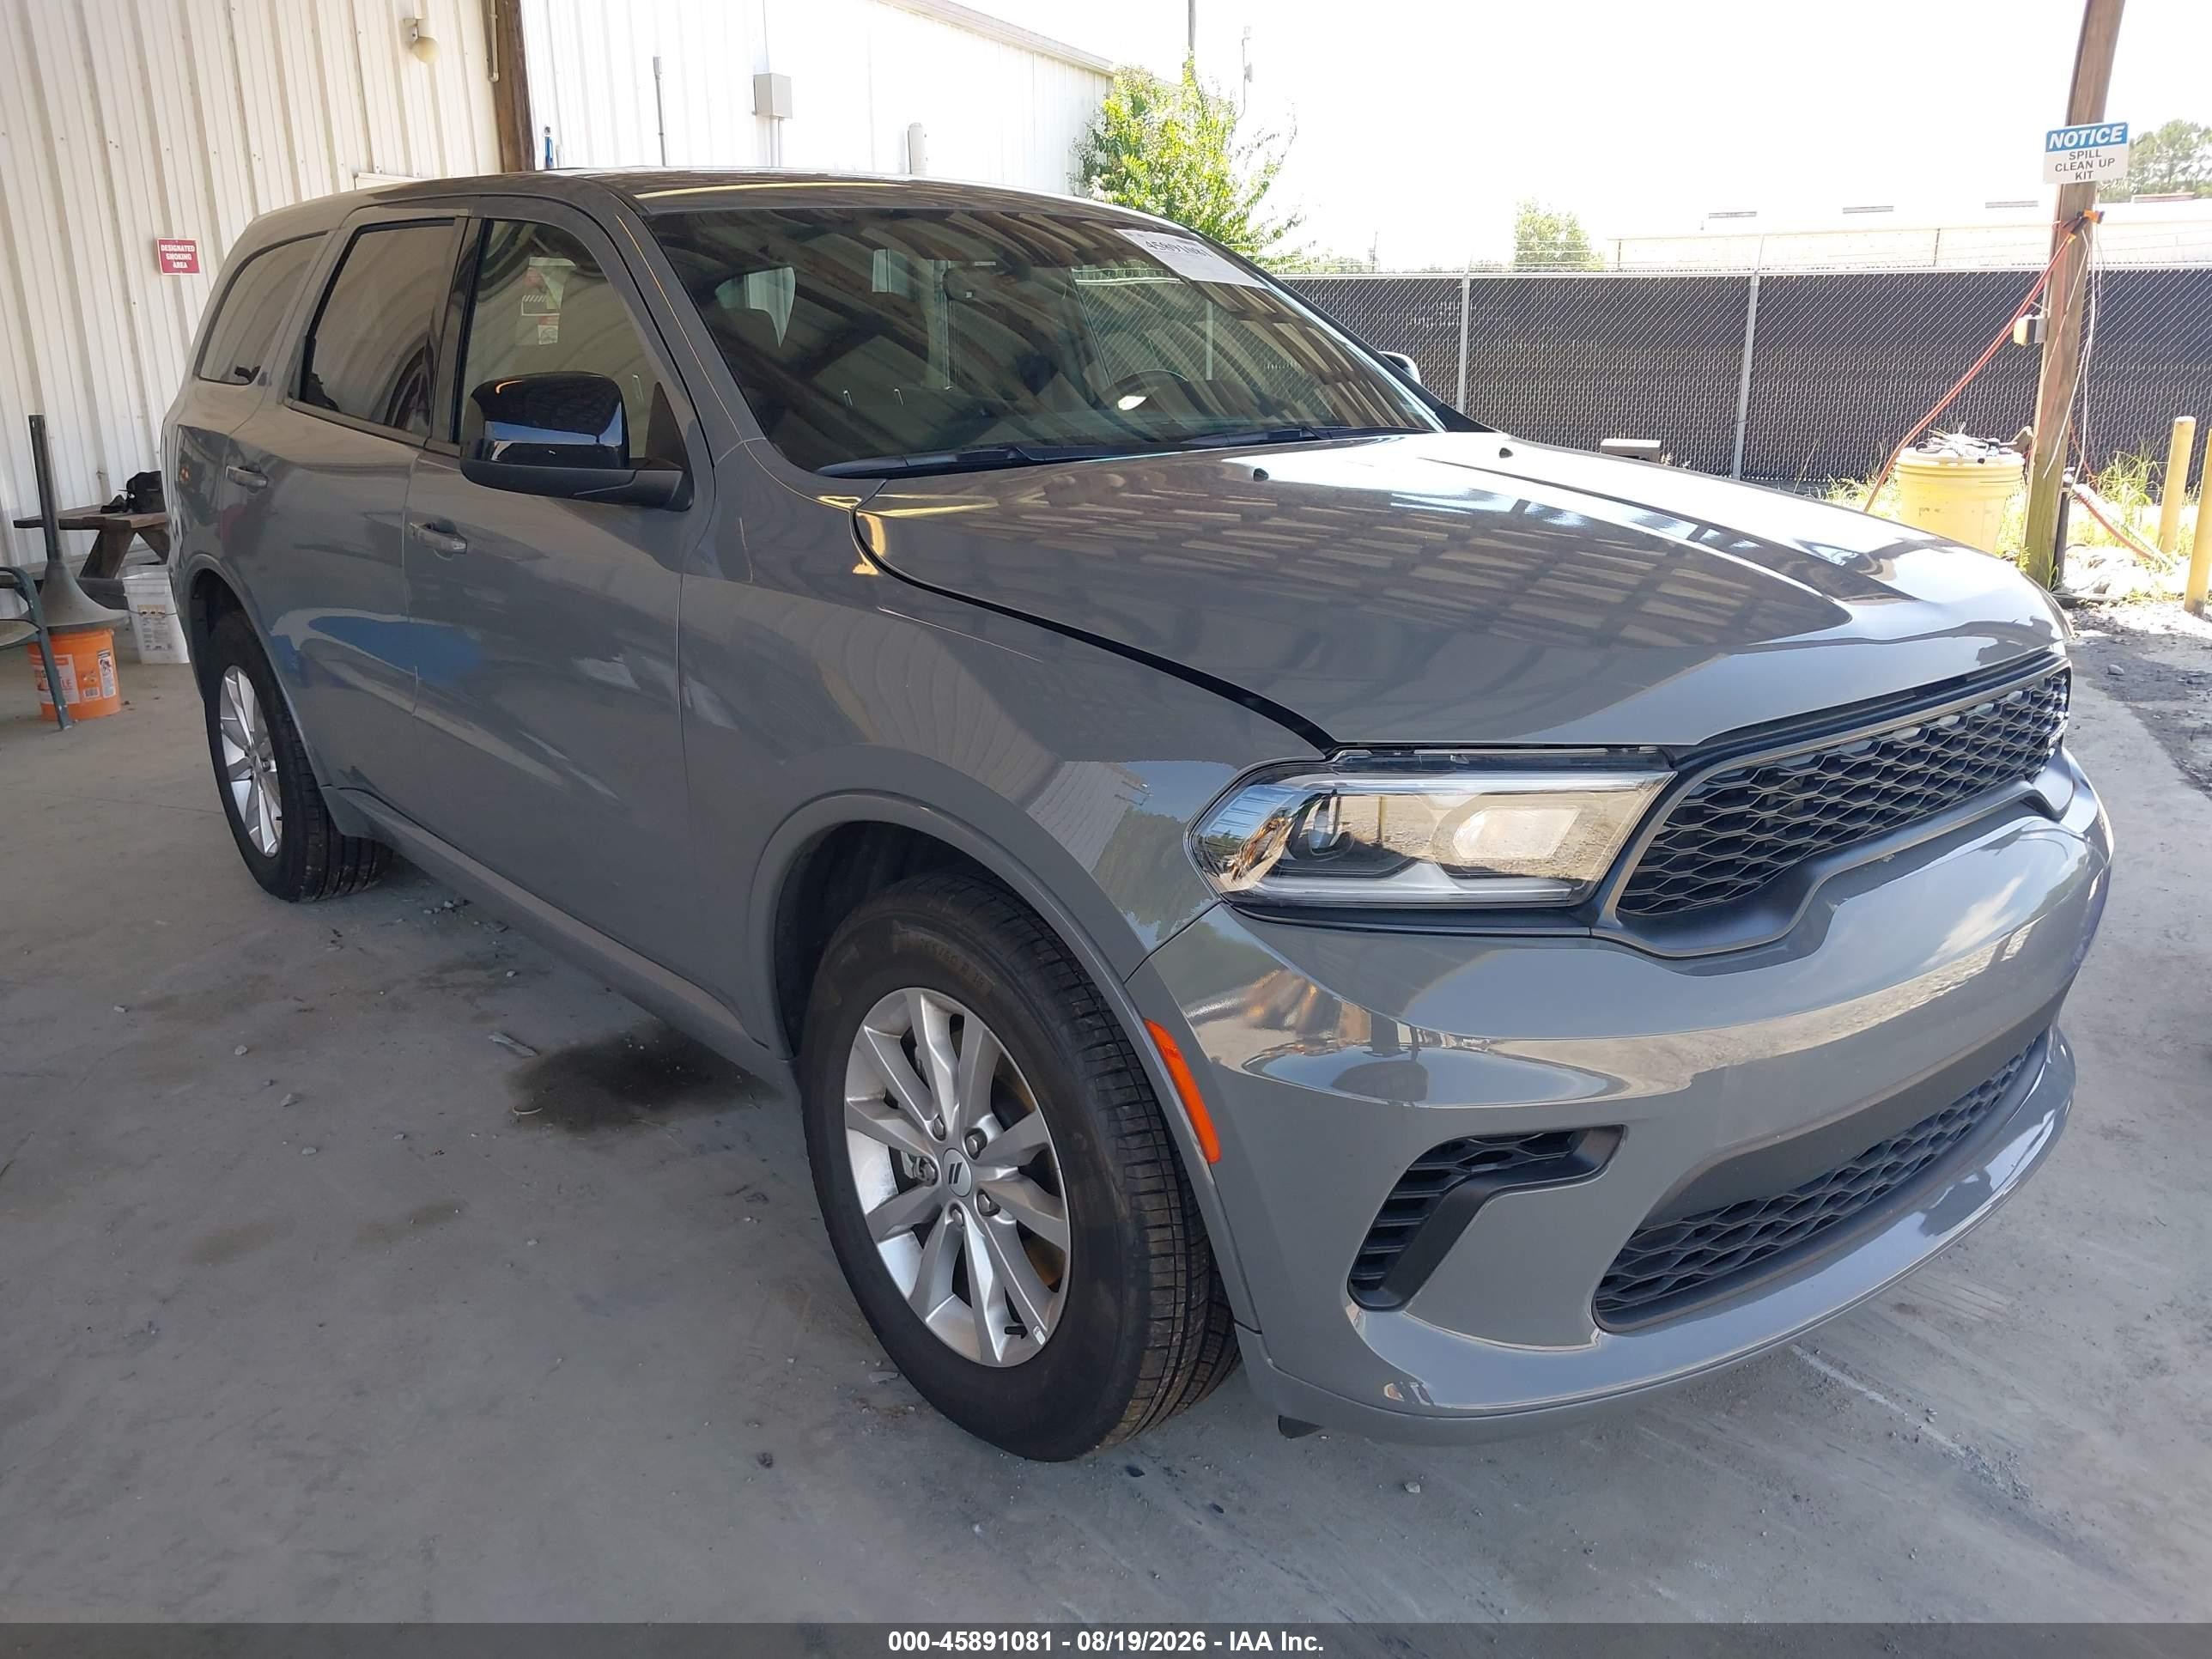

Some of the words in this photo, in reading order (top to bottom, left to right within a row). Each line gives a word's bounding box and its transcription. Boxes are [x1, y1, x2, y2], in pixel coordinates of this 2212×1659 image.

[2048, 125, 2125, 149] NOTICE
[2069, 149, 2102, 161] SPILL
[2055, 161, 2094, 172] CLEAN
[2099, 158, 2115, 167] UP
[2075, 171, 2094, 180] KIT
[161, 244, 196, 252] DESIGNATED
[165, 252, 192, 261] SMOKING
